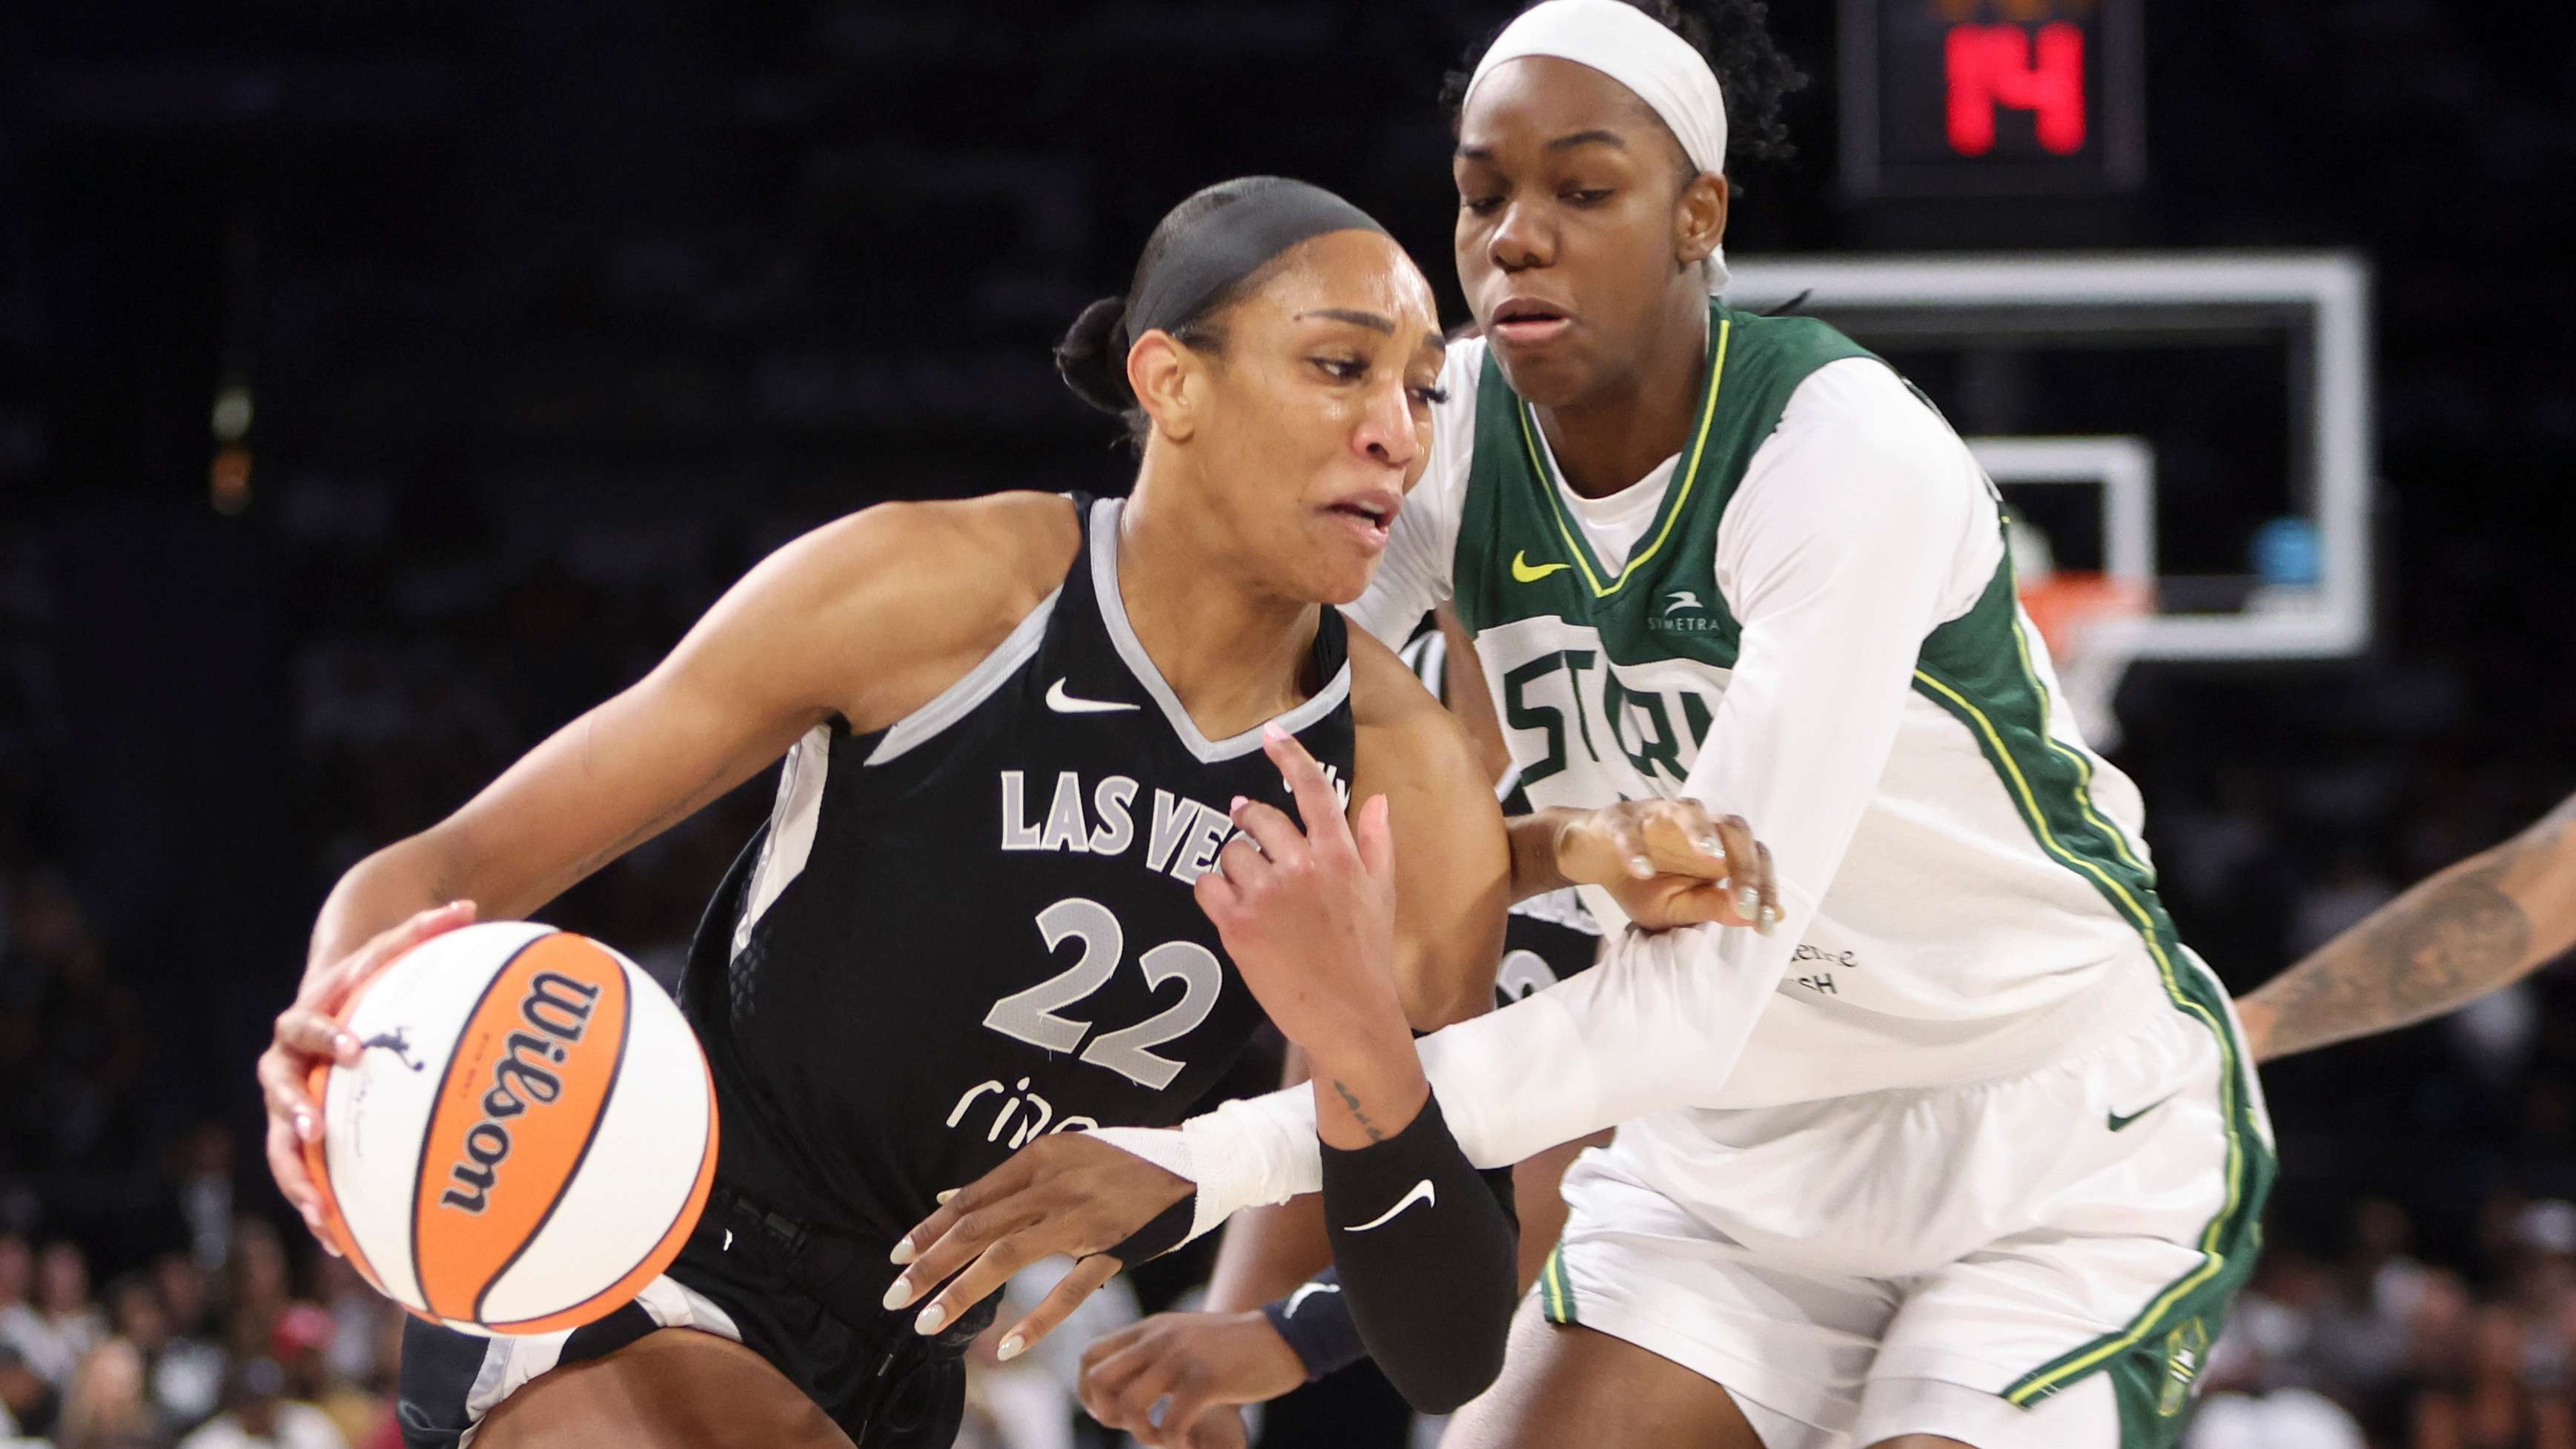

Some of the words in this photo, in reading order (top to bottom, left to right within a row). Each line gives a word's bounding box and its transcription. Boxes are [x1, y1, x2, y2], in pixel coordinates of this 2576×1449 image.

[1946, 22, 2085, 155] 14
[1001, 770, 1139, 855] LAS
[1146, 788, 1262, 886] VE
[983, 898, 1222, 1090] 22
[440, 970, 604, 1216] Wilson
